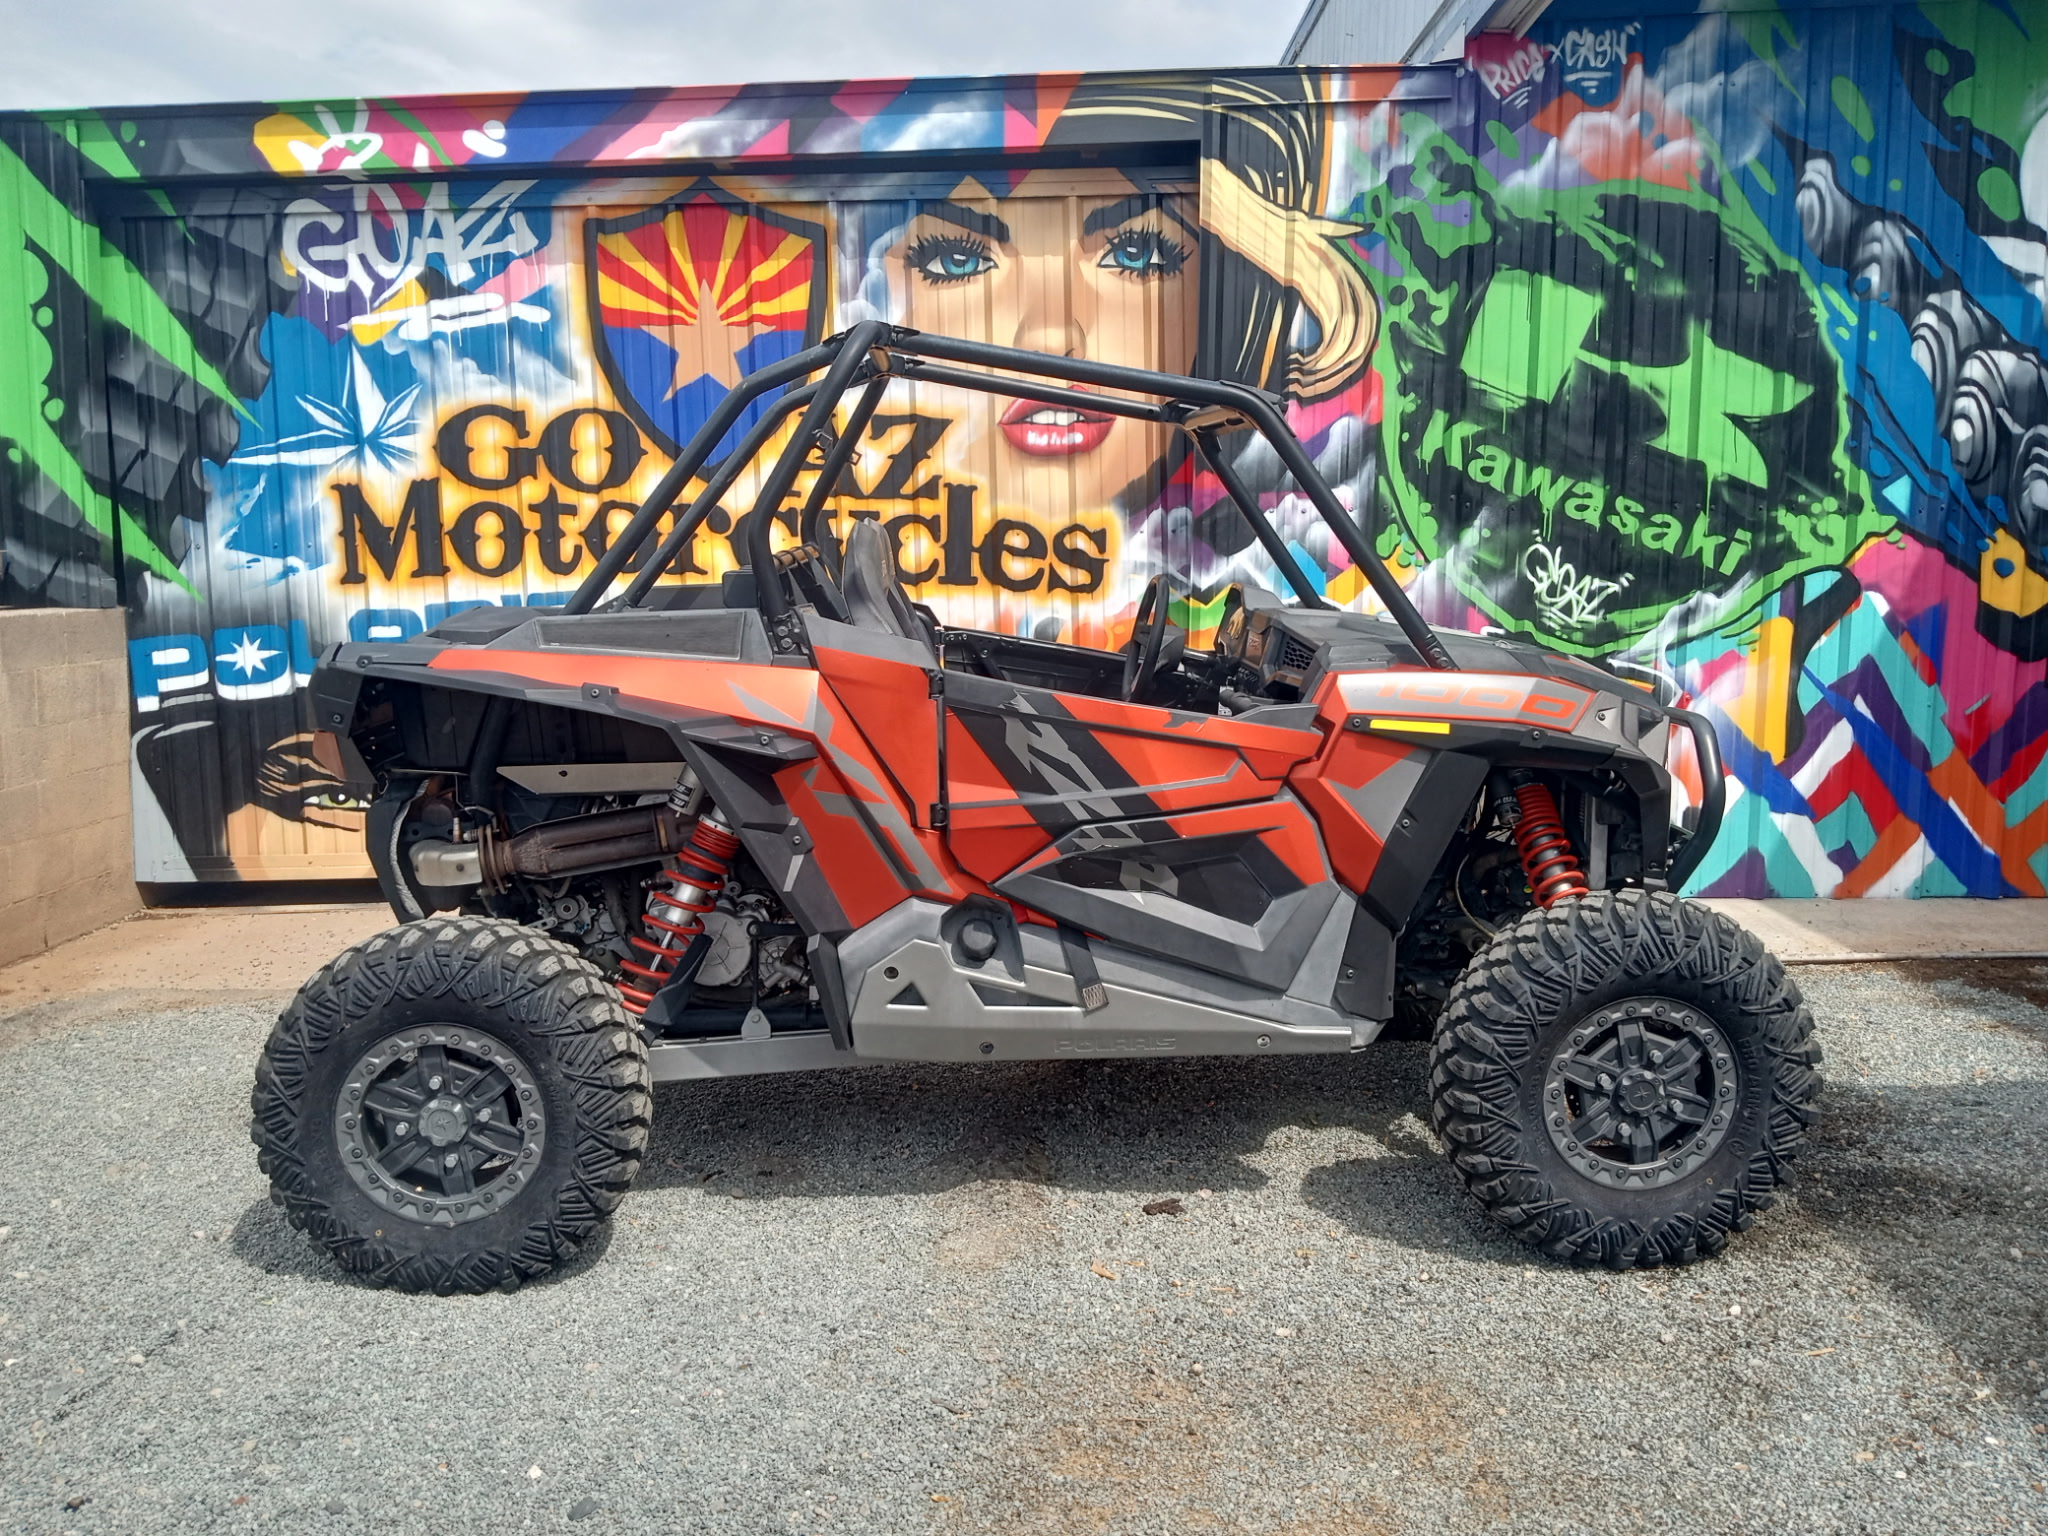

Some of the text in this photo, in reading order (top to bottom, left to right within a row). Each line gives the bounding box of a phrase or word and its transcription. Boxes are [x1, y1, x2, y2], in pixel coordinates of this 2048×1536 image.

[433, 403, 648, 494] GO
[1406, 408, 1752, 576] Kawasaki
[1376, 681, 1577, 720] 1000
